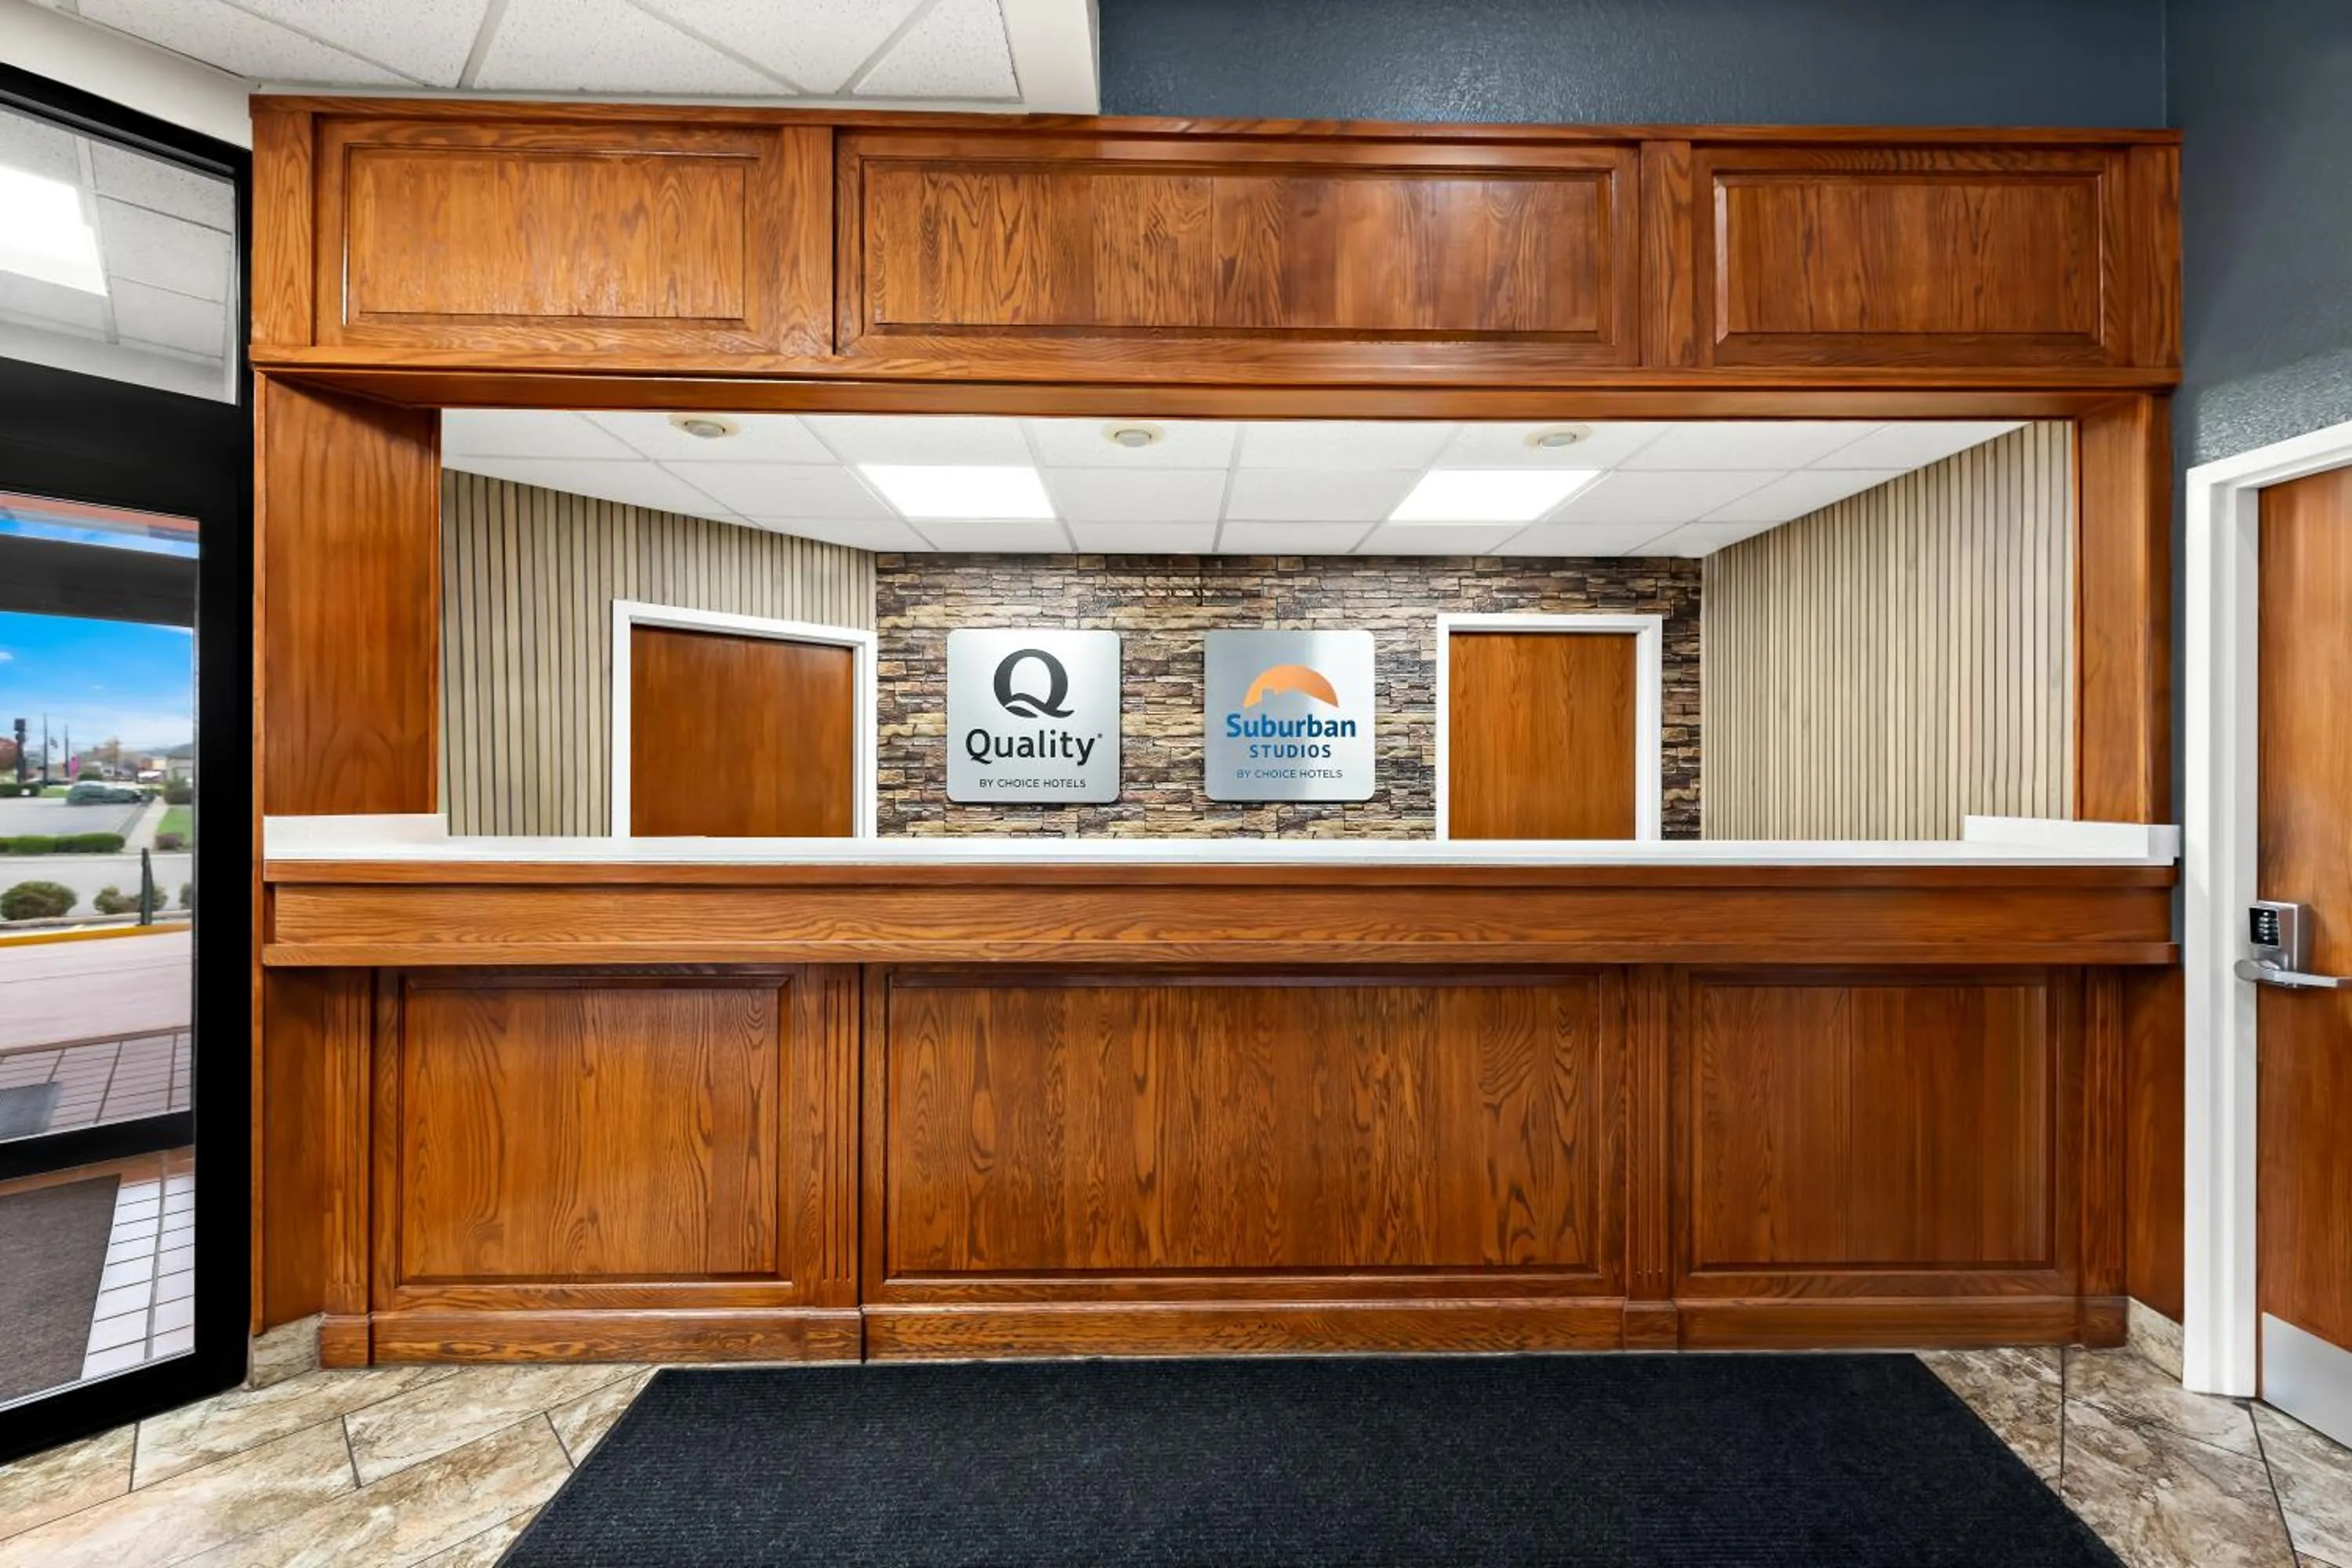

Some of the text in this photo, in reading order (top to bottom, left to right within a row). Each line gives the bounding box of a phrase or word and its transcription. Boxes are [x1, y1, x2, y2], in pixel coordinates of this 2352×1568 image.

[993, 648, 1075, 718] Q
[1226, 713, 1356, 738] Suburban
[965, 728, 1096, 766] Quality
[1249, 744, 1331, 758] STUDIOS
[980, 779, 1087, 788] BY CHOICE HOTELS
[1236, 769, 1343, 779] BY CHOICE HOTELS
